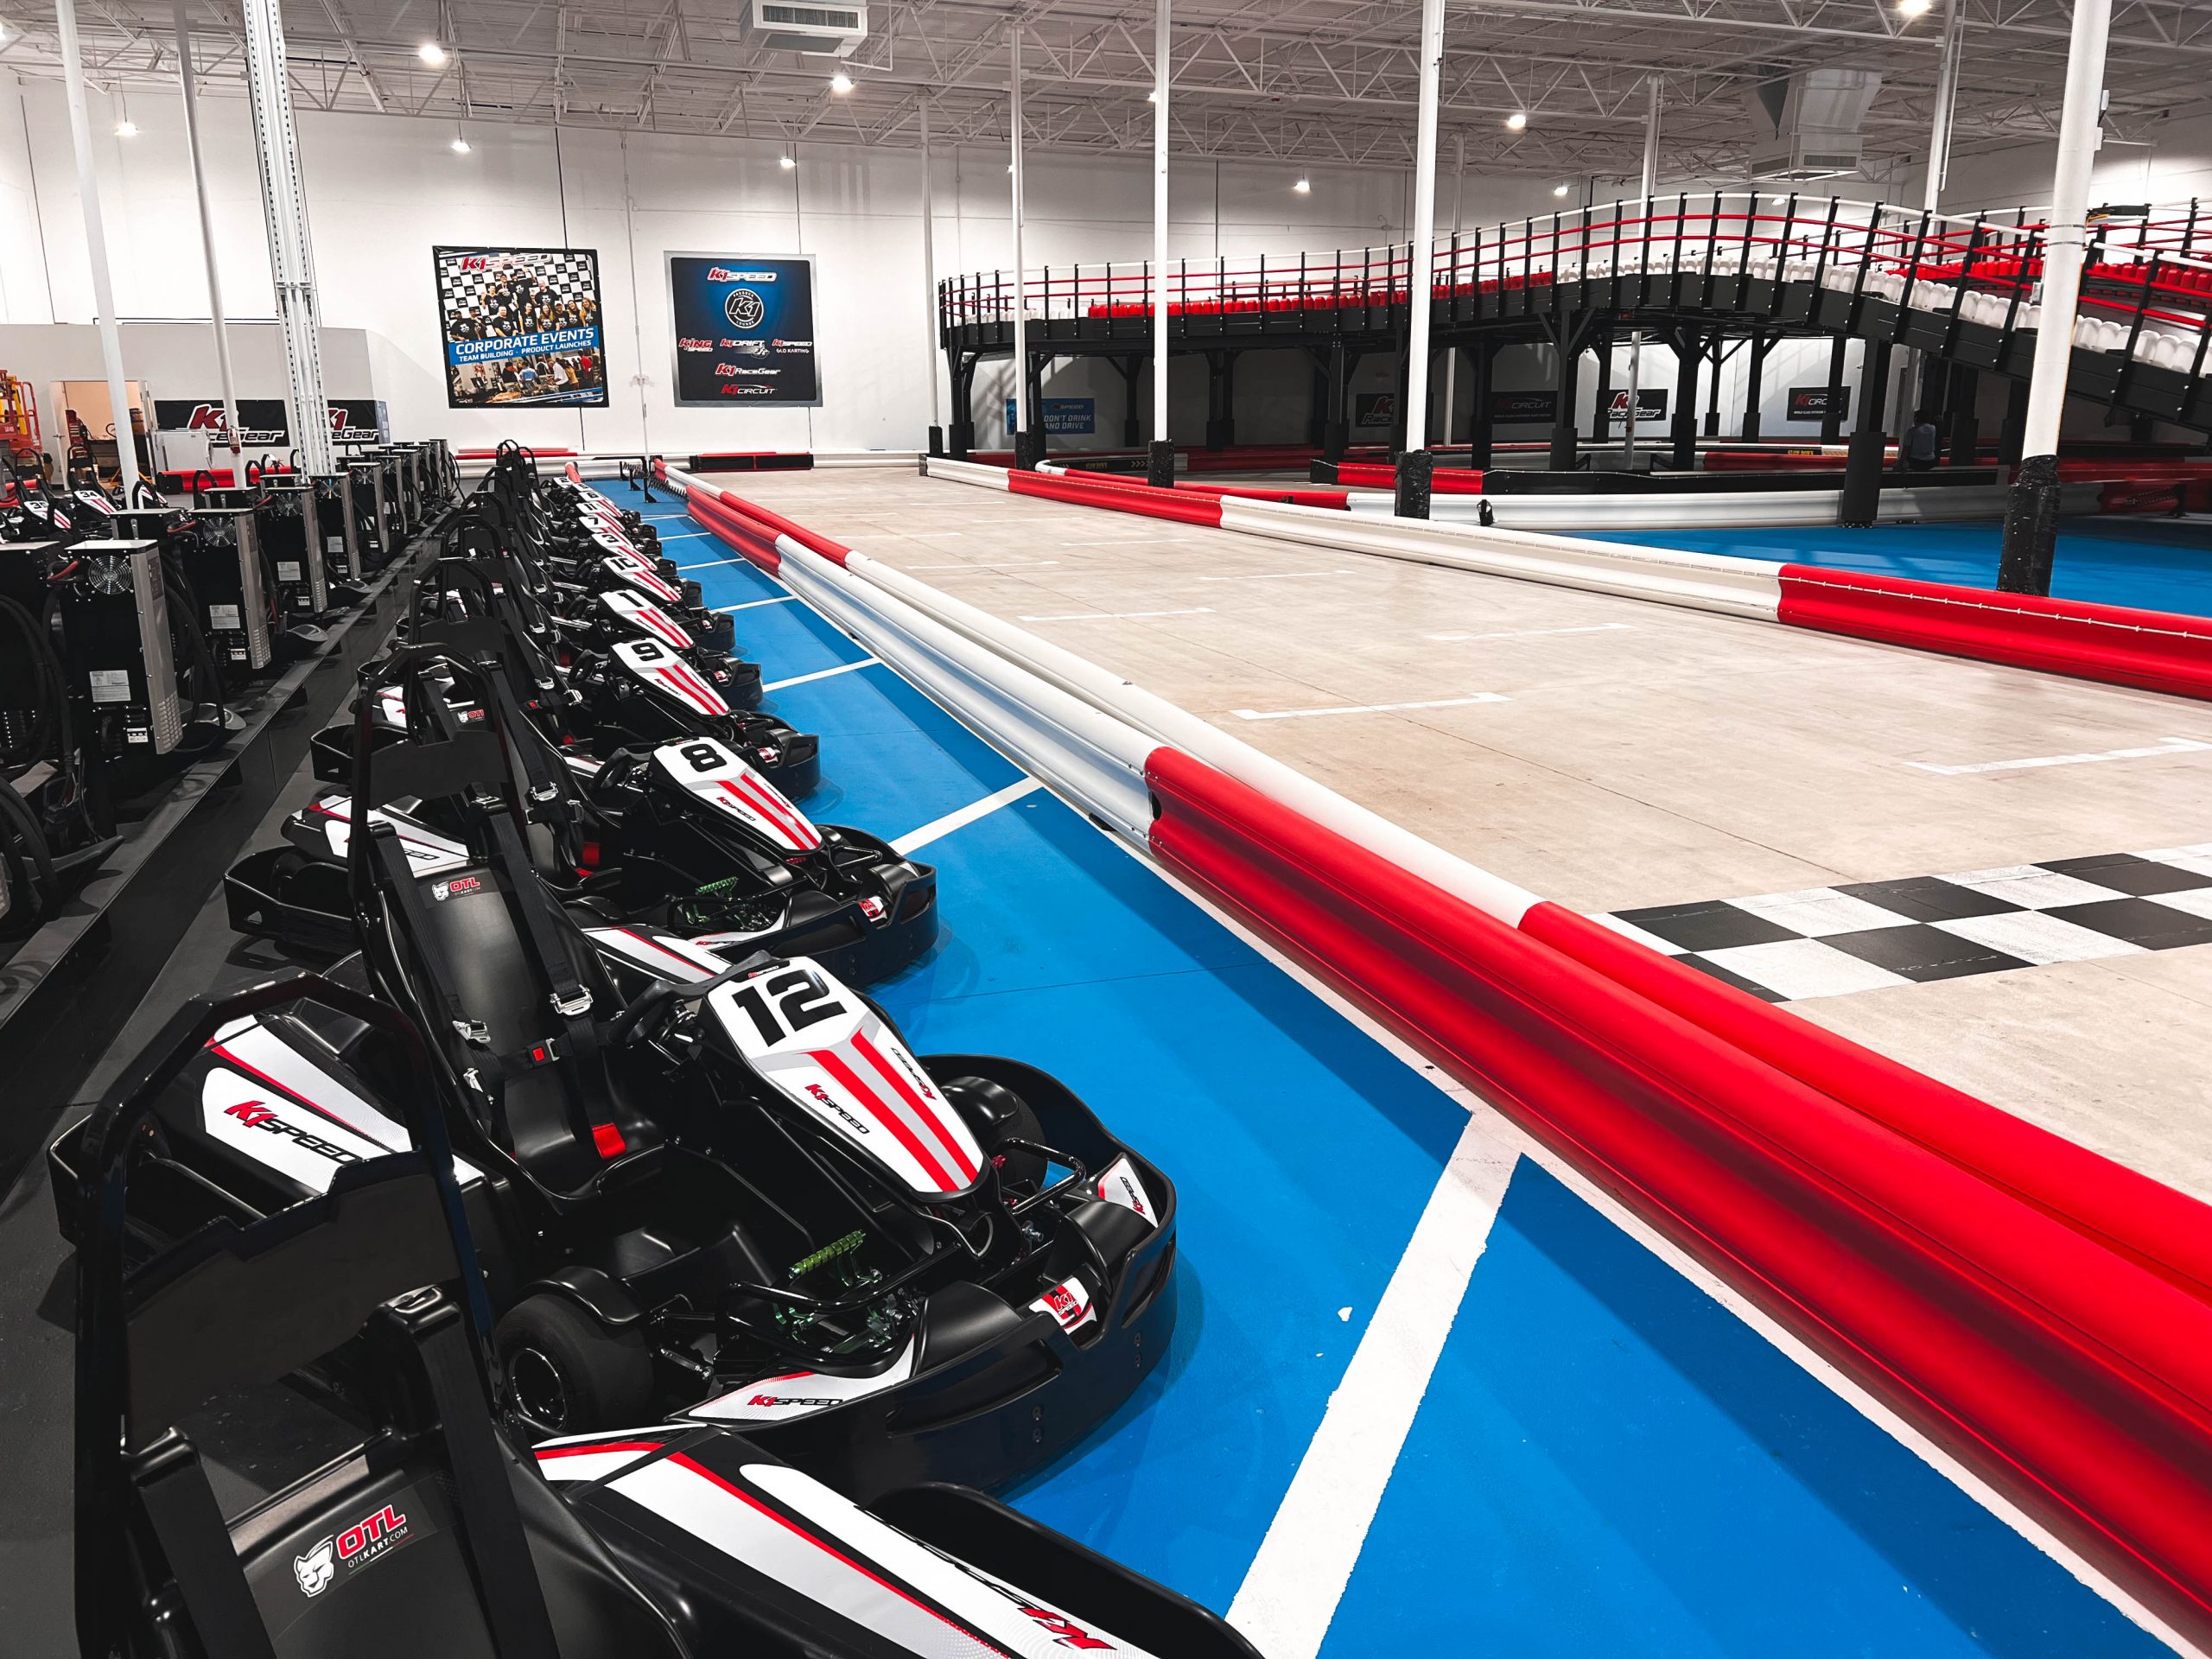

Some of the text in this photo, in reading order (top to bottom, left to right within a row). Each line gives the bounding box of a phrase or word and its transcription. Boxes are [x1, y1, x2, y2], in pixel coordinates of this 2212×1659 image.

[728, 297, 760, 317] K1
[455, 327, 594, 355] CORPORATE EVENTS
[480, 350, 513, 360] BUILDING
[521, 345, 553, 354] PRODUCT
[555, 340, 592, 351] LAUNCHES
[602, 534, 620, 543] 3
[616, 592, 644, 607] 1
[631, 642, 664, 662] 9
[680, 743, 728, 773] 8
[449, 877, 480, 892] OTL
[731, 969, 848, 1047] 12
[223, 1100, 364, 1165] K1SPEED
[1053, 1291, 1076, 1311] K1
[336, 1504, 406, 1560] OTL
[347, 1526, 408, 1568] OTLKART.COM
